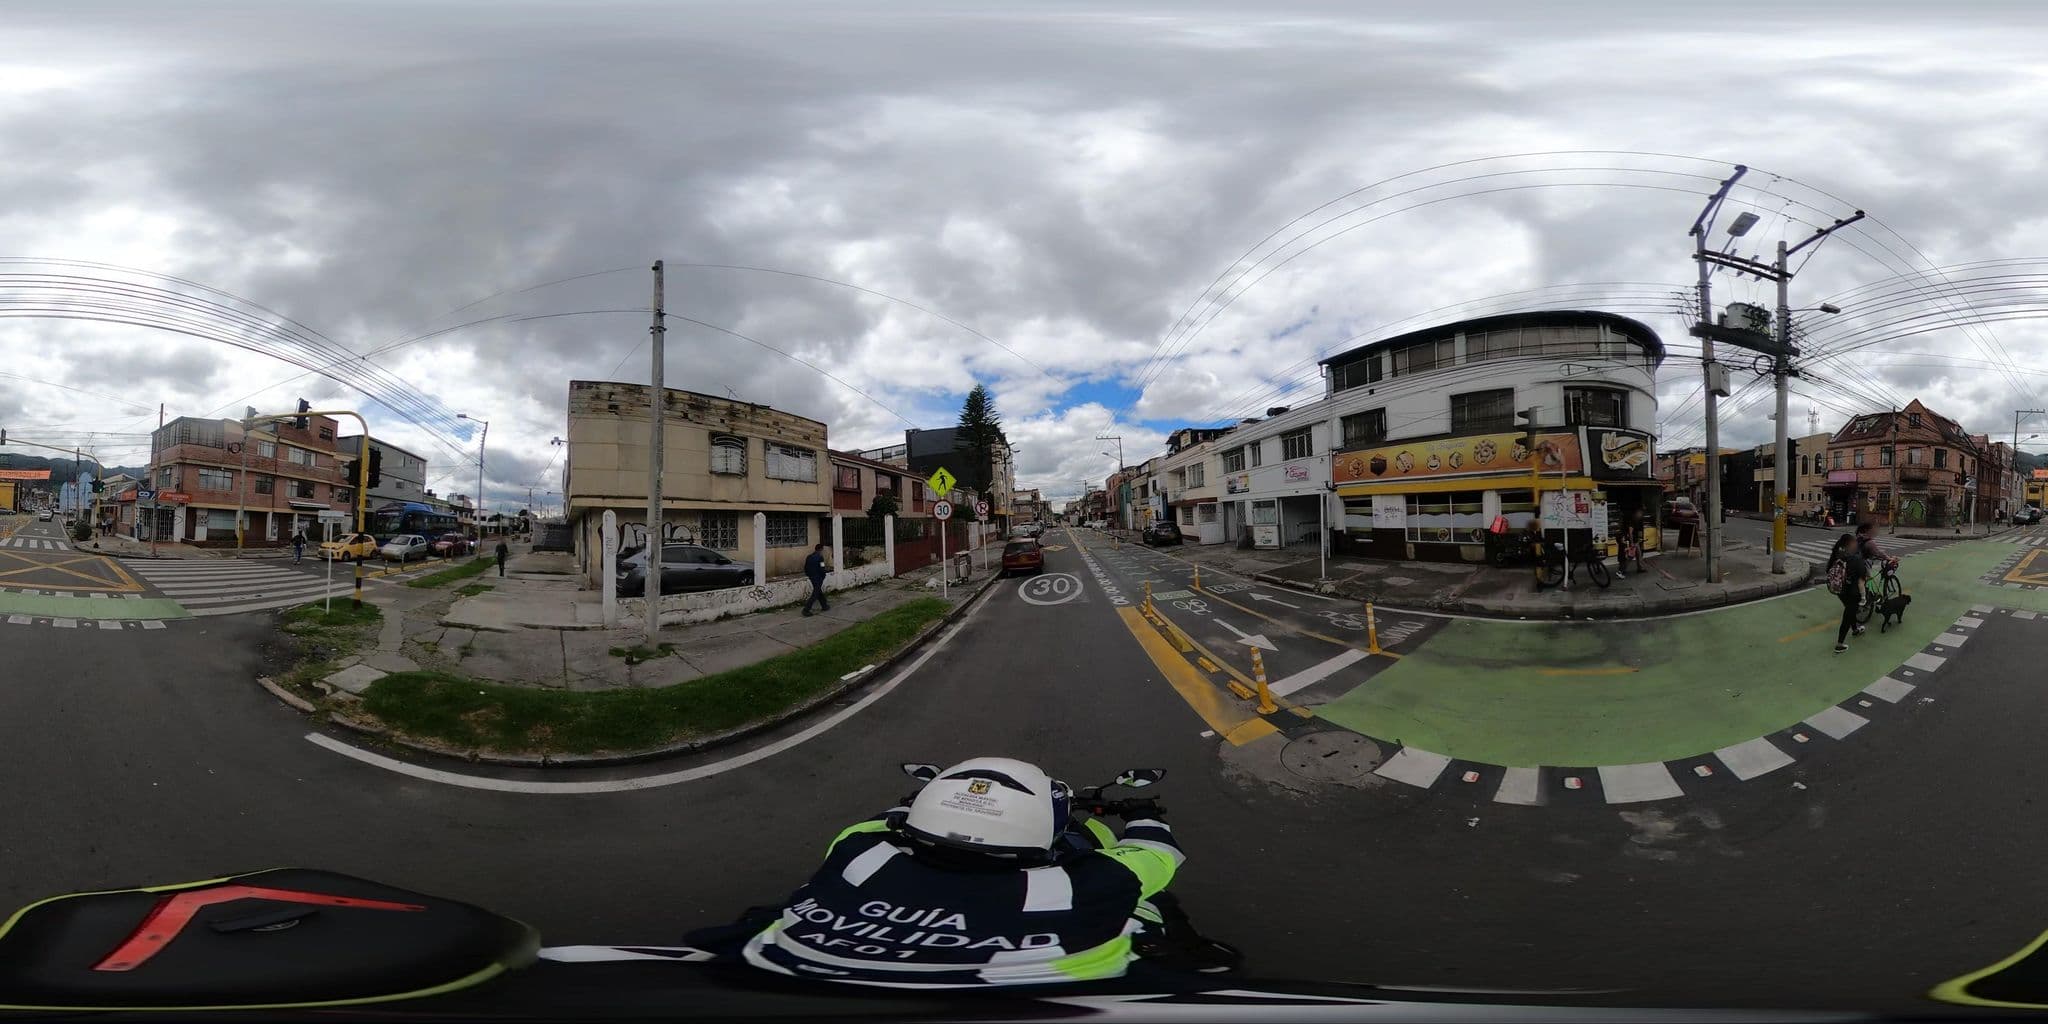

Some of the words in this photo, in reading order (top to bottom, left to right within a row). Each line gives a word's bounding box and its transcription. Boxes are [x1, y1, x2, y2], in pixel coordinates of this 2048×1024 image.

[936, 504, 950, 516] 30
[1032, 577, 1071, 596] 30
[792, 897, 1061, 950] MOVILIDAD
[858, 899, 967, 931] GUÍA
[799, 932, 918, 959] AF01
